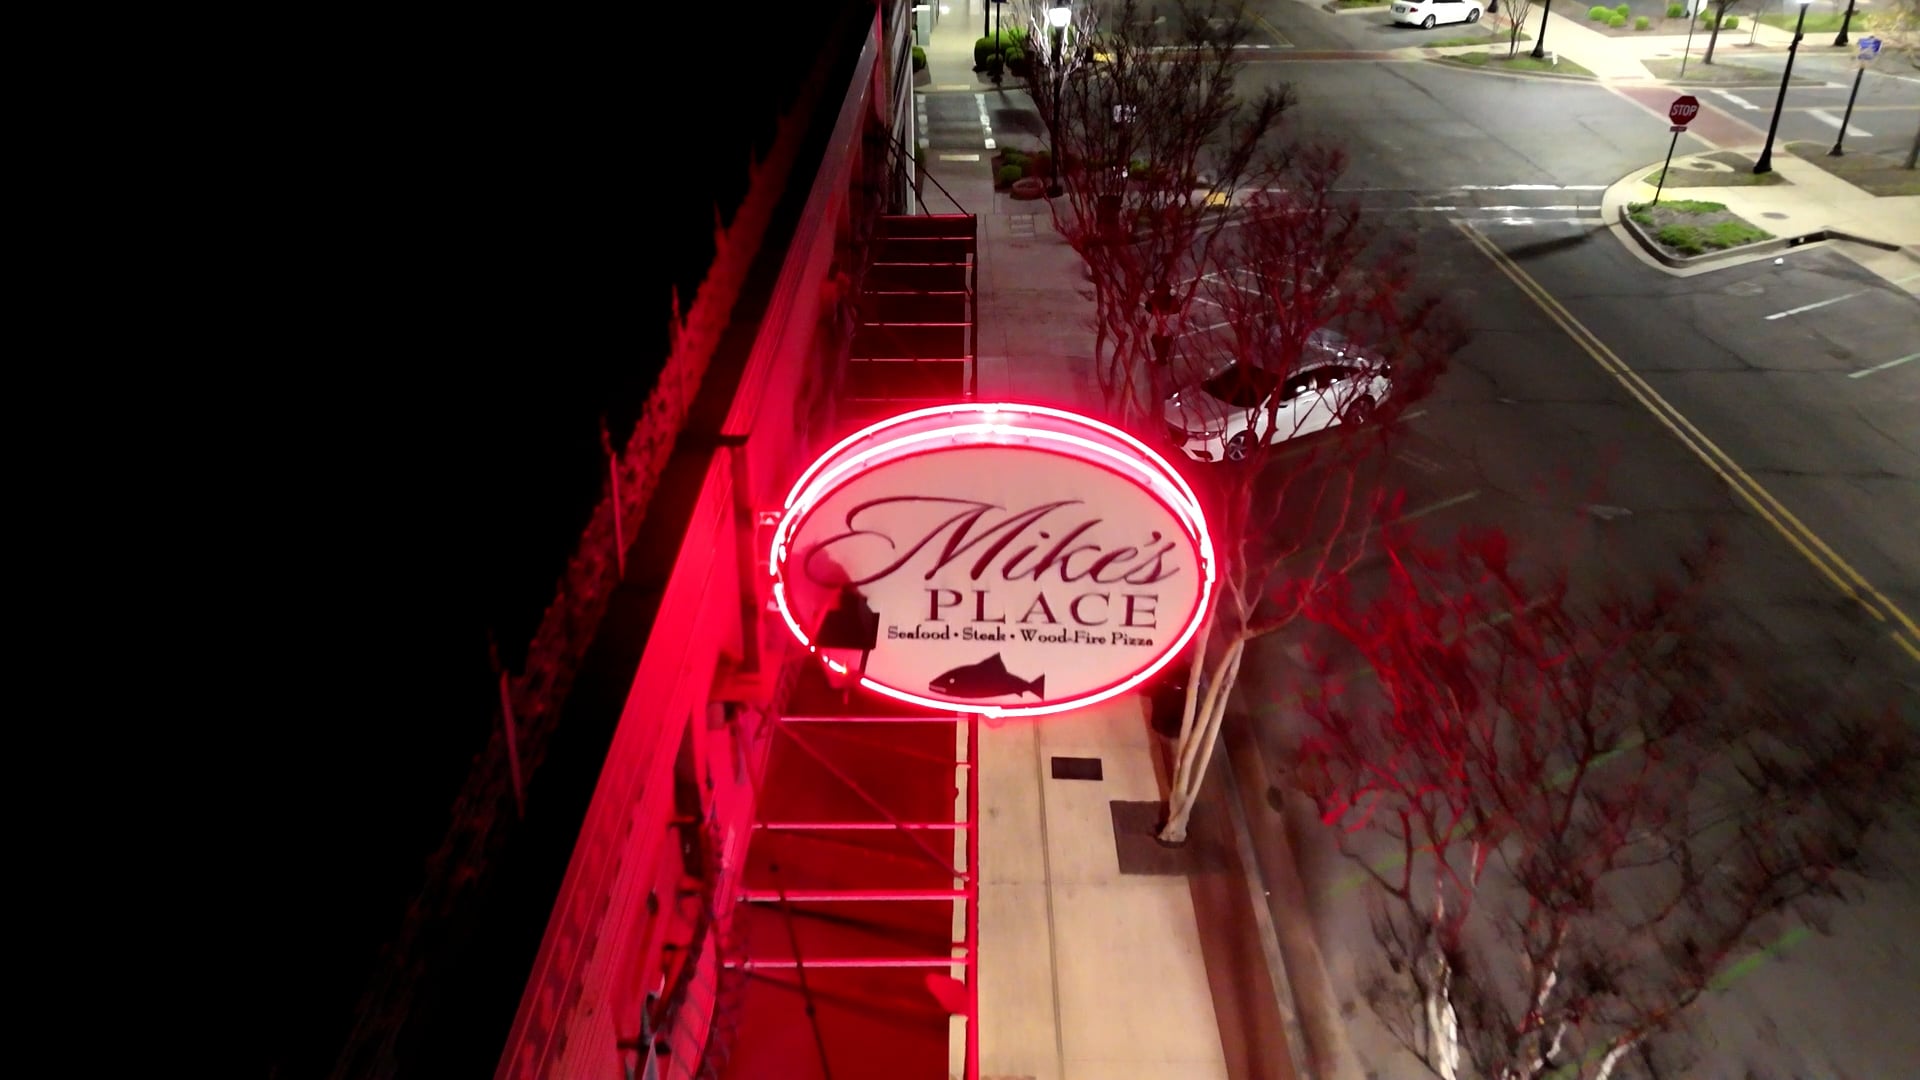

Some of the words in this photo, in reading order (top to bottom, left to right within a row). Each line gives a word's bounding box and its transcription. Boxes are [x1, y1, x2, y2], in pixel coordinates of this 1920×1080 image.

[1671, 104, 1697, 116] STOP
[804, 496, 1180, 586] Mike's
[924, 588, 1158, 629] PLACE
[888, 624, 950, 640] Seafood
[962, 626, 1006, 641] Steak
[1112, 631, 1153, 646] Pizza
